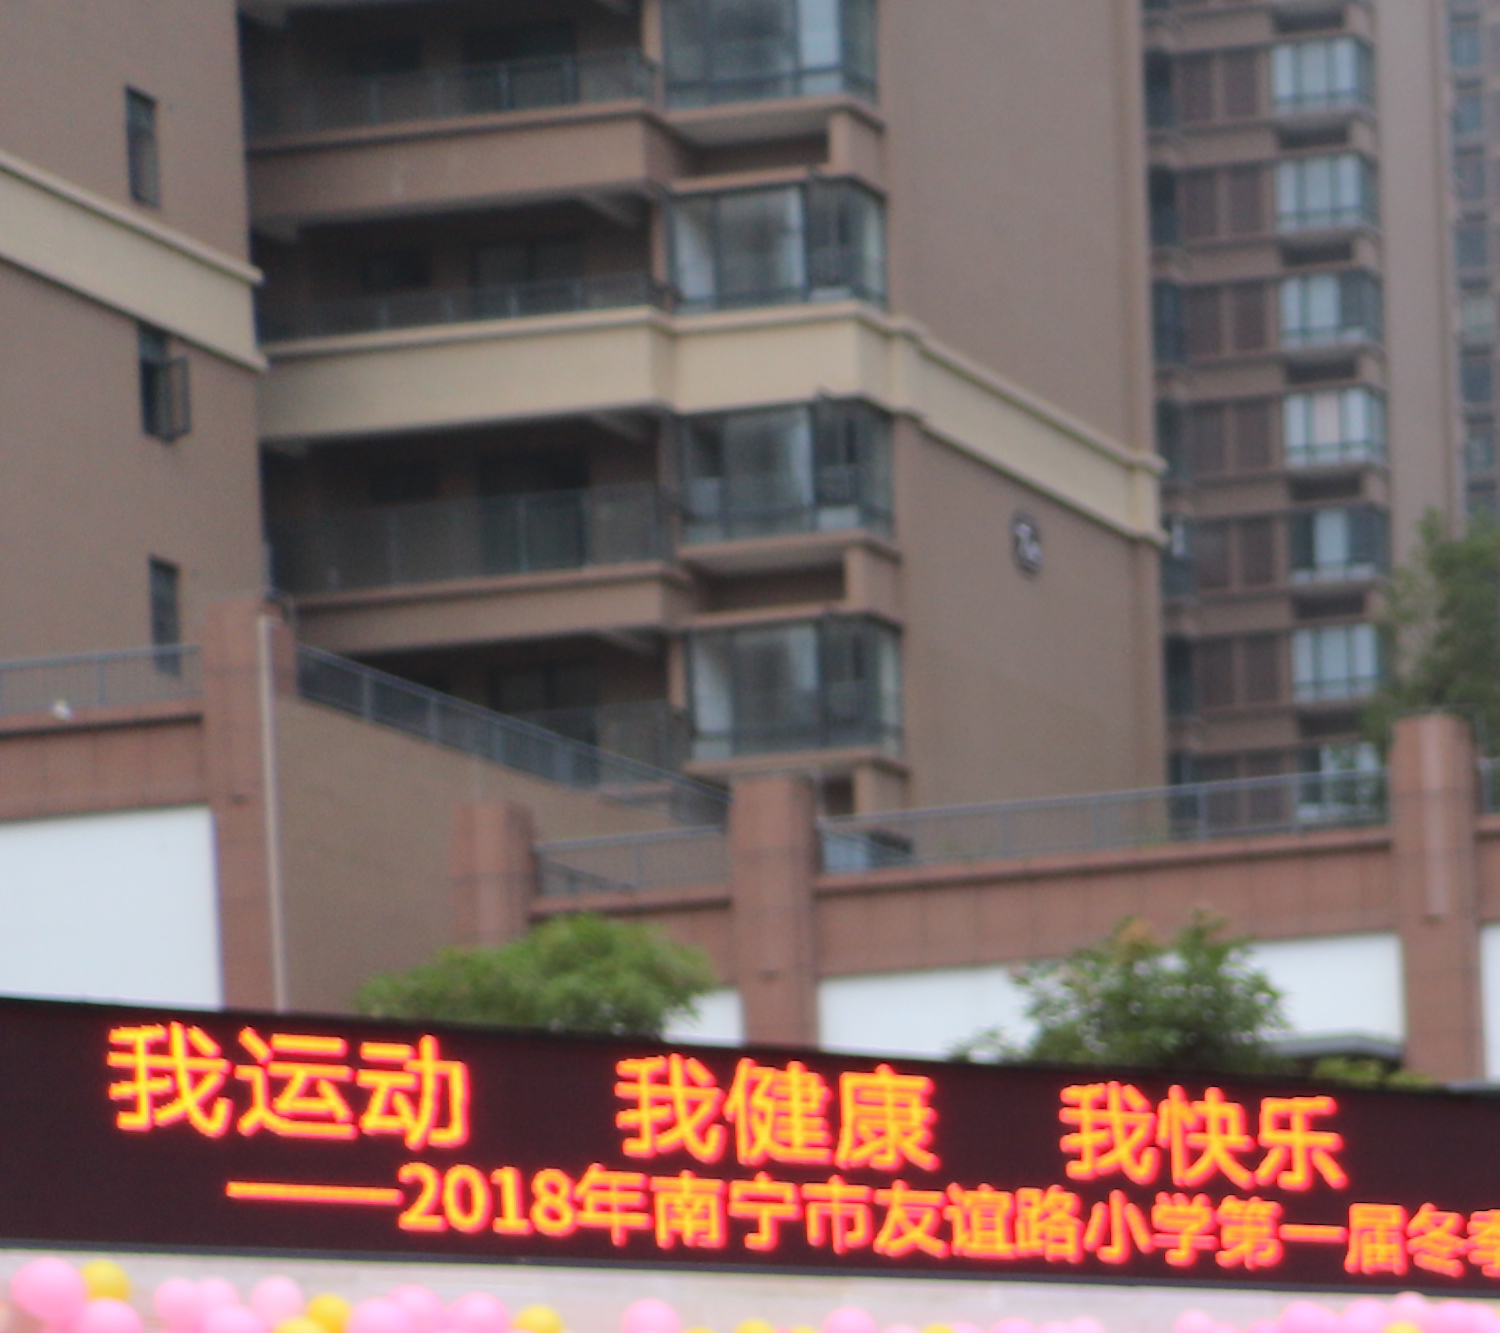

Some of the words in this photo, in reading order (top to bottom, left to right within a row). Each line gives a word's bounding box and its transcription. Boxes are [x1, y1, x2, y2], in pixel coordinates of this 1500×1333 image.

[105, 1020, 472, 1152] 我运动
[614, 1052, 942, 1174] 我健康
[1057, 1080, 1350, 1193] 我快乐
